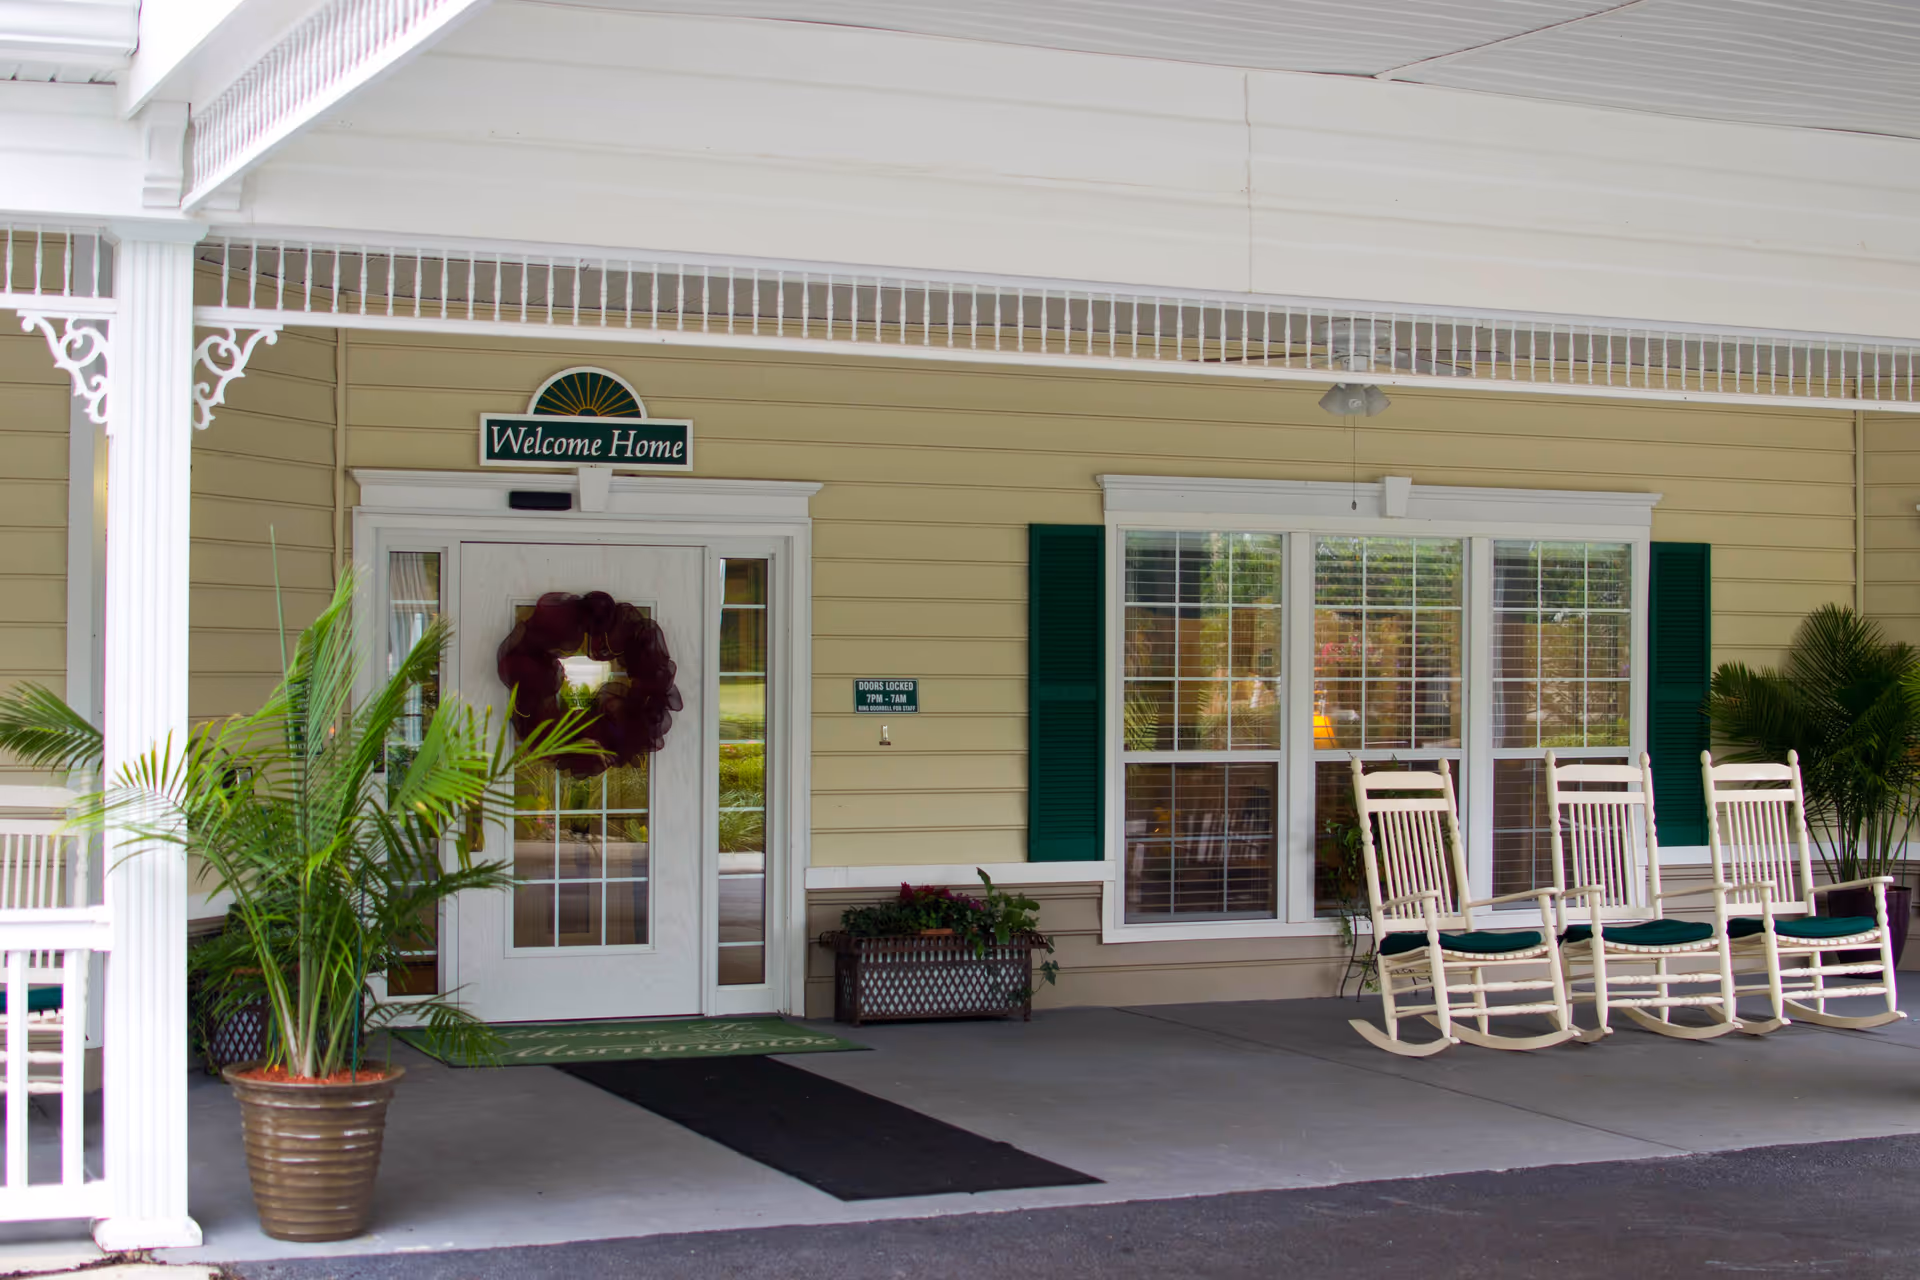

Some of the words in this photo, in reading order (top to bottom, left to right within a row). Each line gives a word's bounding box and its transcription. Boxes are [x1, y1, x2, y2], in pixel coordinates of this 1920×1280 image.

[491, 426, 602, 455] Welcome
[608, 430, 684, 459] Home
[859, 681, 884, 691] DOORS
[885, 681, 914, 691] LOCKED
[866, 694, 883, 703] 7PM
[890, 694, 907, 703] 7AM
